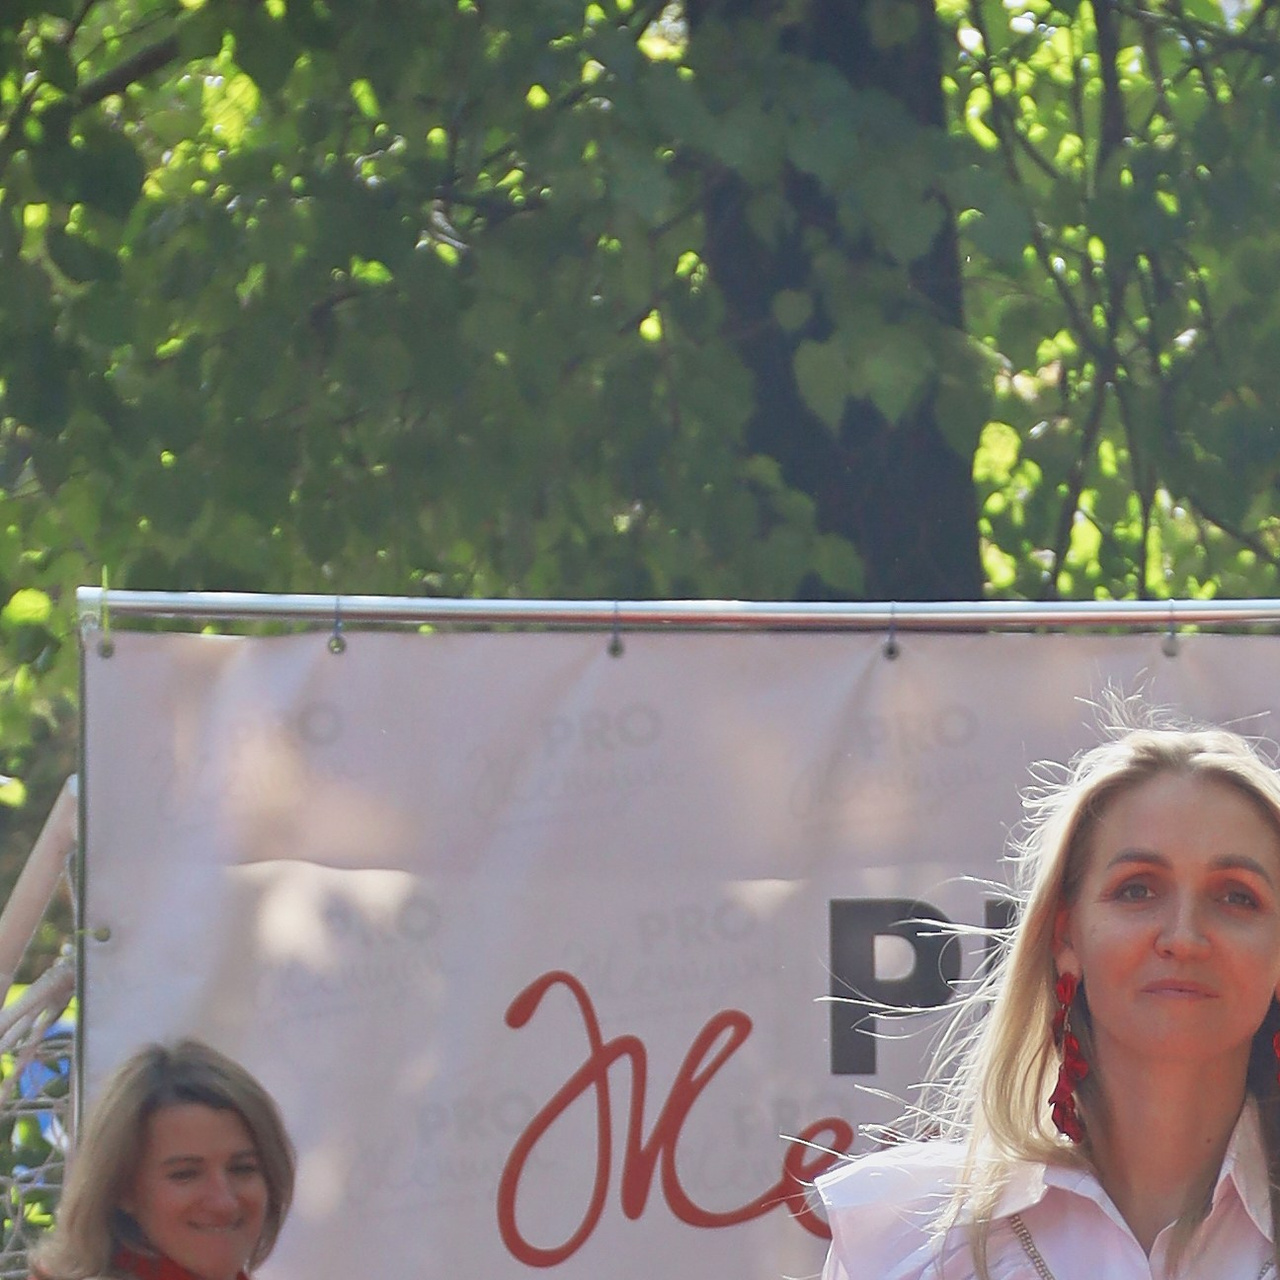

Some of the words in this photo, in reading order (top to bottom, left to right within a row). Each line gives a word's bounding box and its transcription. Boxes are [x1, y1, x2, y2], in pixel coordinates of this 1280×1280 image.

[541, 702, 664, 757] PRO
[636, 902, 760, 956] PRO
[828, 897, 1022, 1075] P
[497, 970, 858, 1269] Же
